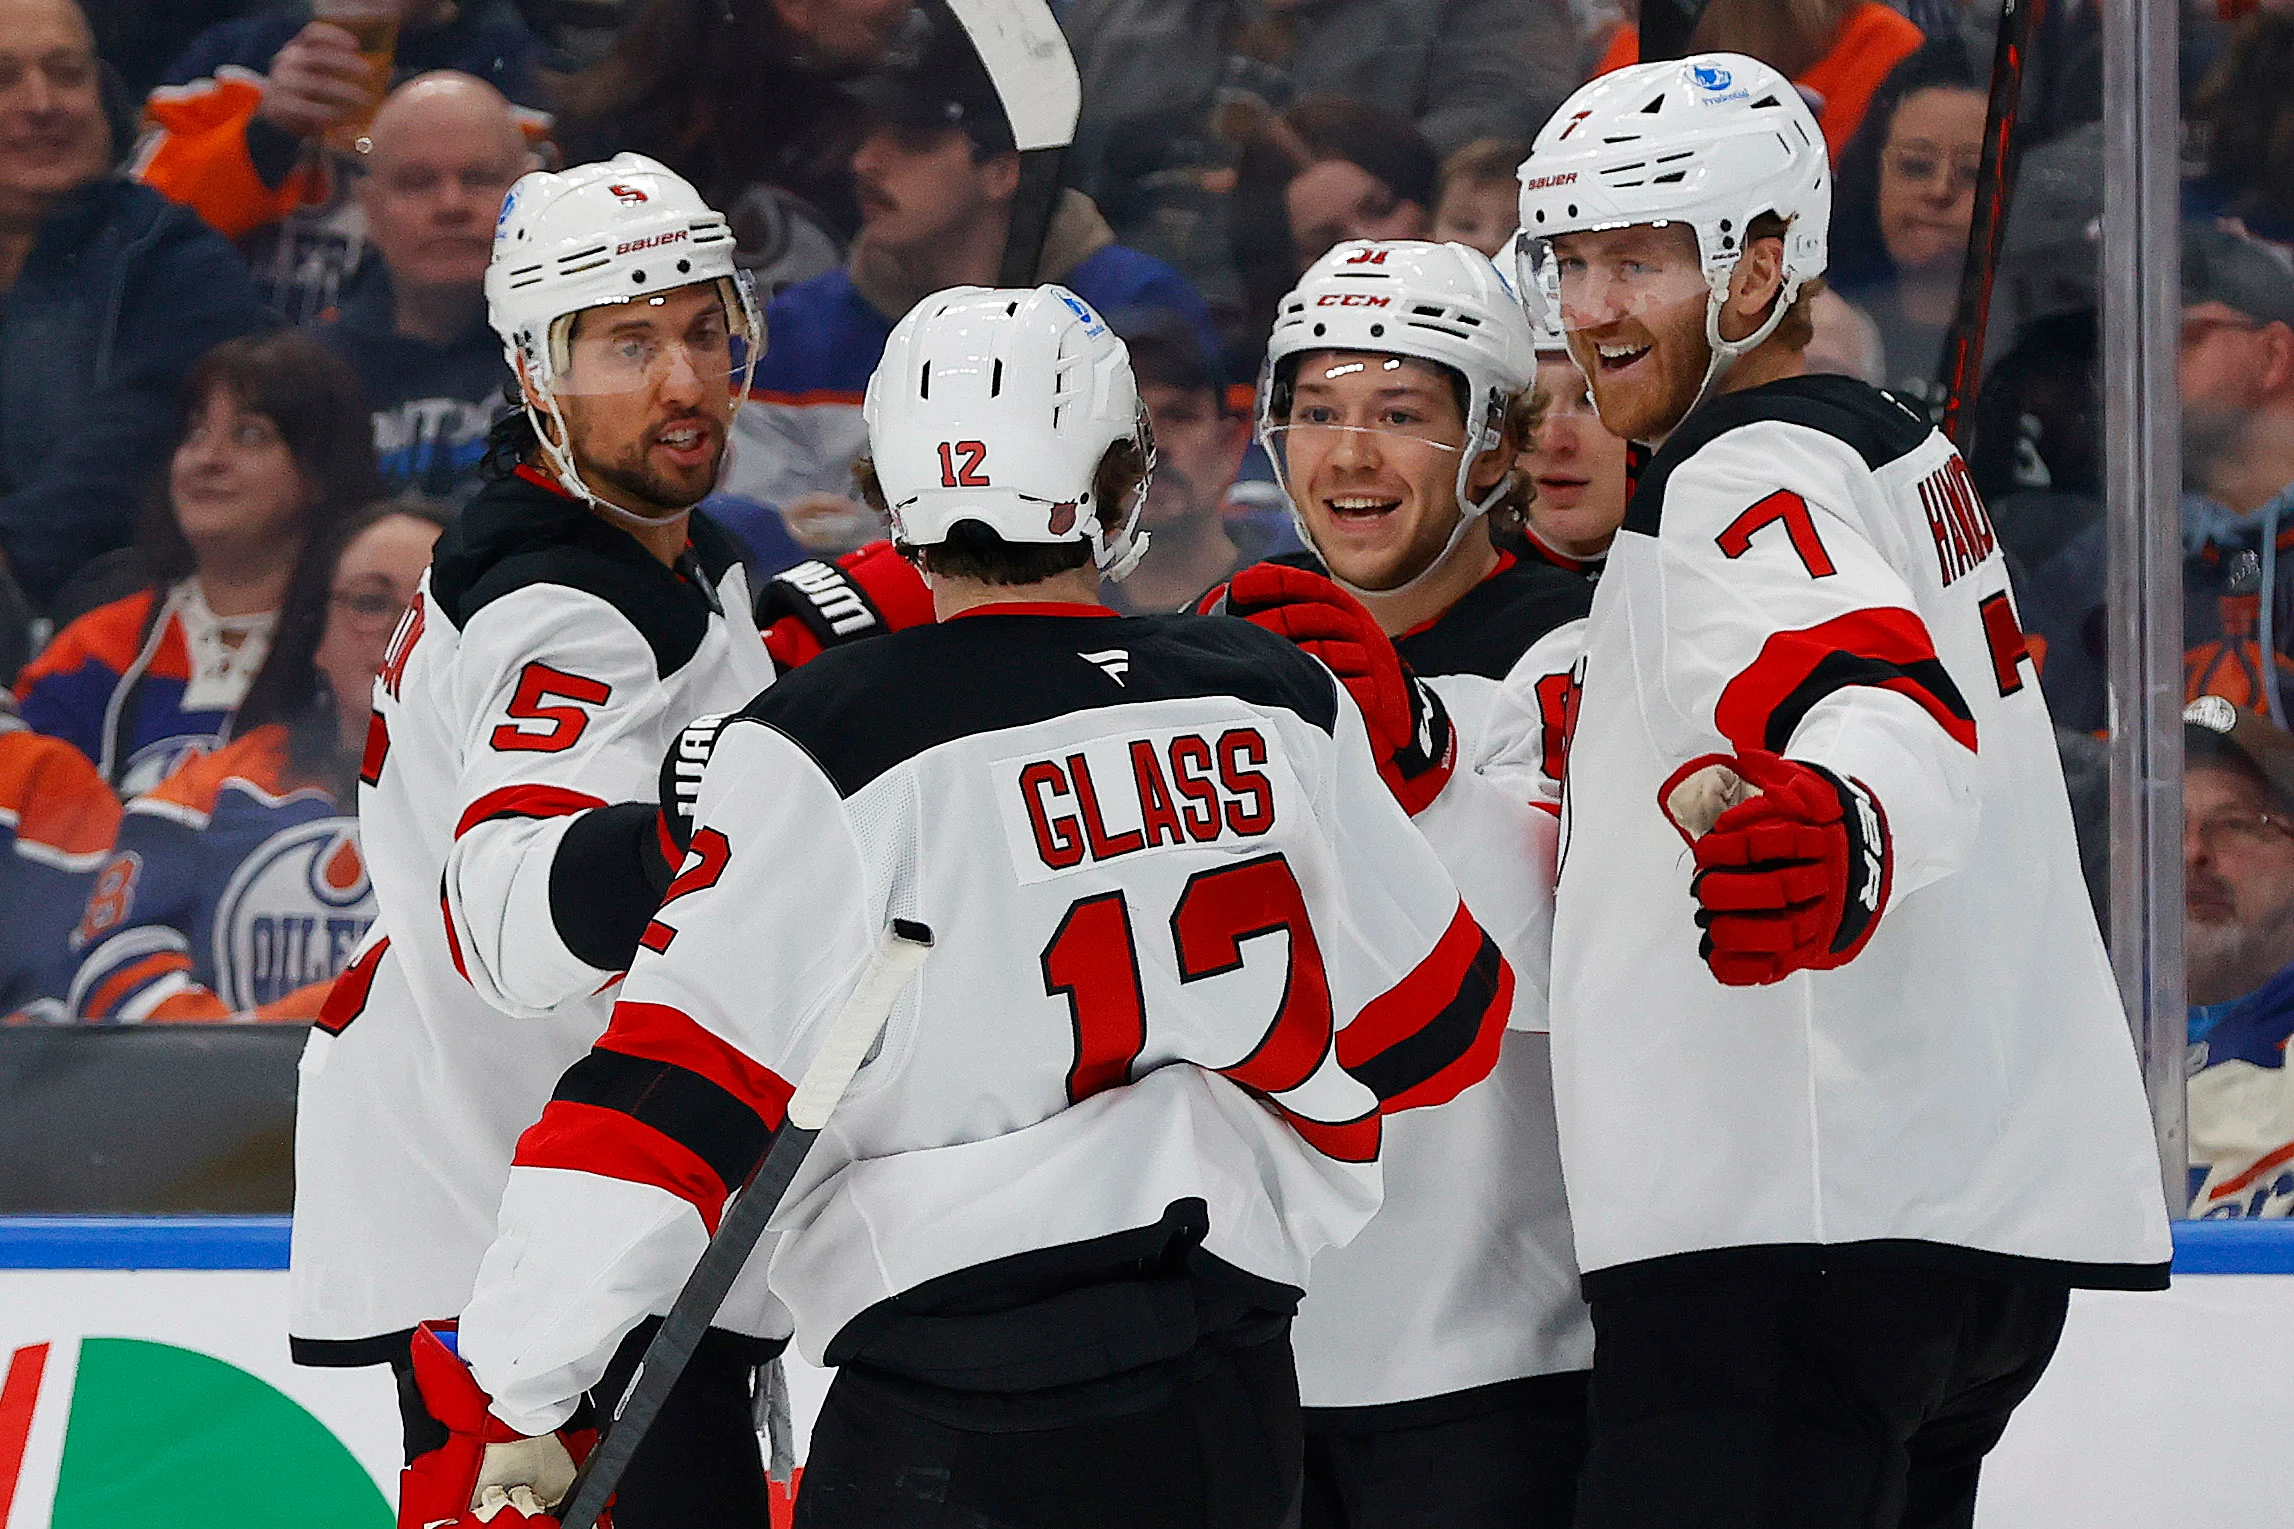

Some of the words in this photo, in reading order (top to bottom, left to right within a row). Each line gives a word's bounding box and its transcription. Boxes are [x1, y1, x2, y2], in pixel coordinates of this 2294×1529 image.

[1559, 110, 1592, 141] 7
[608, 184, 649, 205] 5
[1527, 171, 1578, 191] BAUER
[616, 229, 689, 256] BAUER
[1316, 294, 1392, 308] CCM
[937, 440, 991, 488] 12
[1714, 488, 1837, 580] 7
[489, 661, 613, 753] 5
[1018, 727, 1275, 871] GLASS
[1040, 852, 1383, 1163] 12
